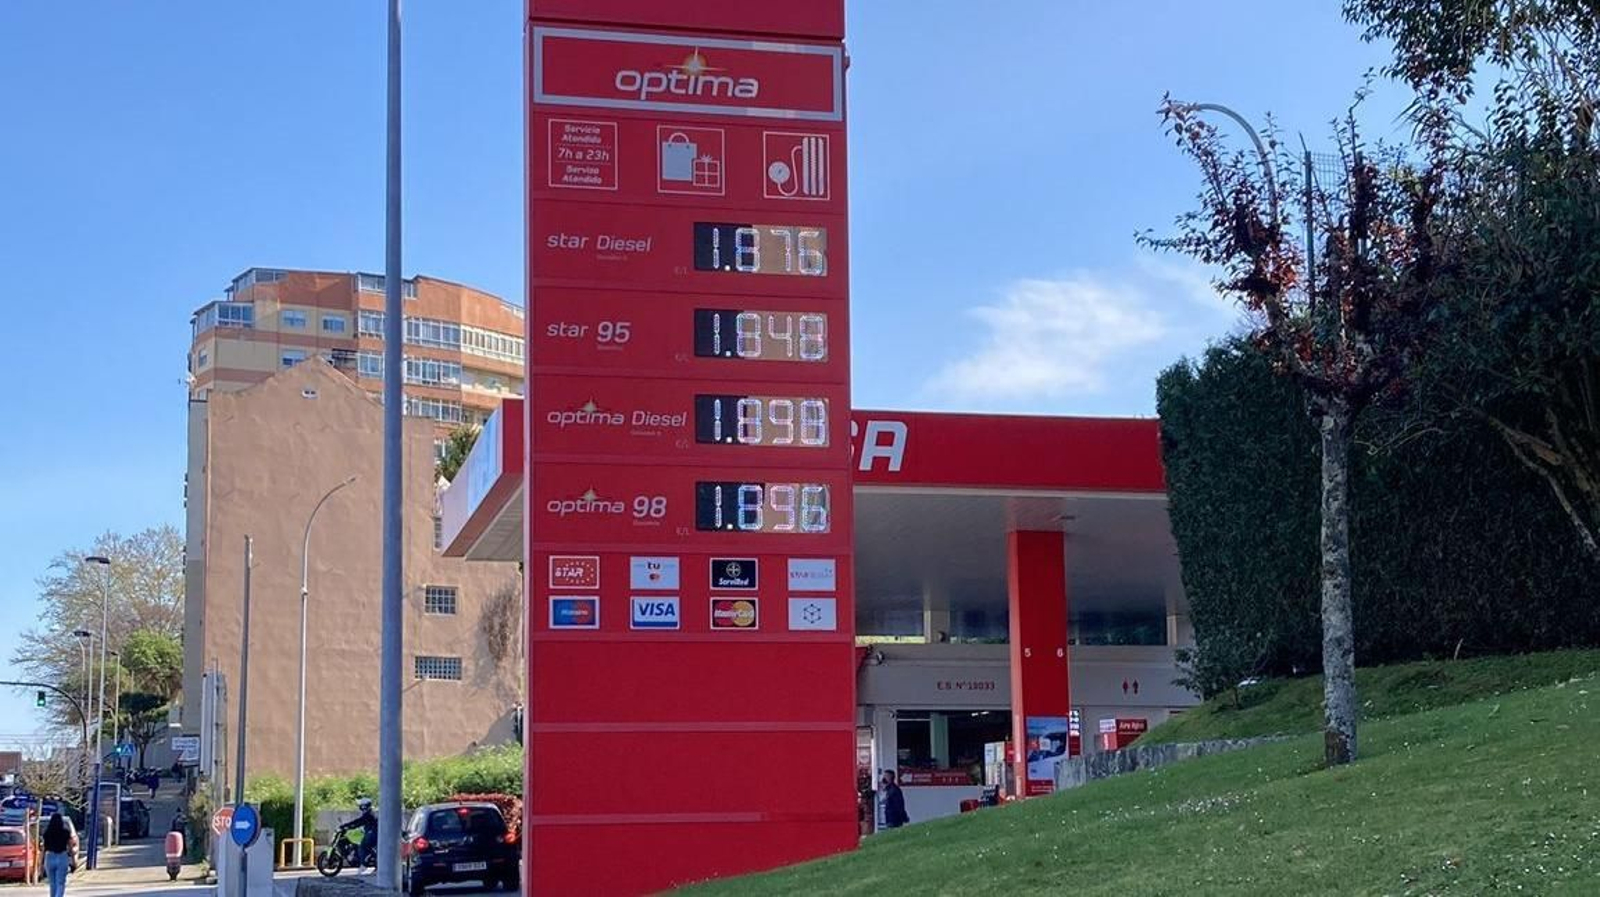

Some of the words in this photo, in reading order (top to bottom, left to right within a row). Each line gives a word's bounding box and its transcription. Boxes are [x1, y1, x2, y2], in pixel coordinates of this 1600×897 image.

[615, 68, 758, 100] optima
[562, 134, 601, 144] Atendido
[558, 147, 573, 159] 7h
[575, 151, 583, 159] a
[586, 150, 609, 161] 23h
[547, 233, 589, 249] star
[597, 235, 652, 252] Diesel
[712, 227, 823, 275] 1.876
[547, 322, 589, 337] star
[597, 321, 631, 343] 95
[713, 312, 825, 359] 1.848
[547, 409, 625, 428] optima
[632, 410, 687, 427] Diesel
[714, 399, 826, 445] 1.898
[850, 420, 908, 471] A
[547, 499, 625, 517] optima
[633, 496, 667, 517] 98
[715, 485, 827, 531] 1.896
[647, 561, 660, 570] tu
[639, 603, 676, 617] VISA
[1024, 647, 1032, 658] 5
[1056, 647, 1064, 658] 6
[214, 816, 234, 828] STO
